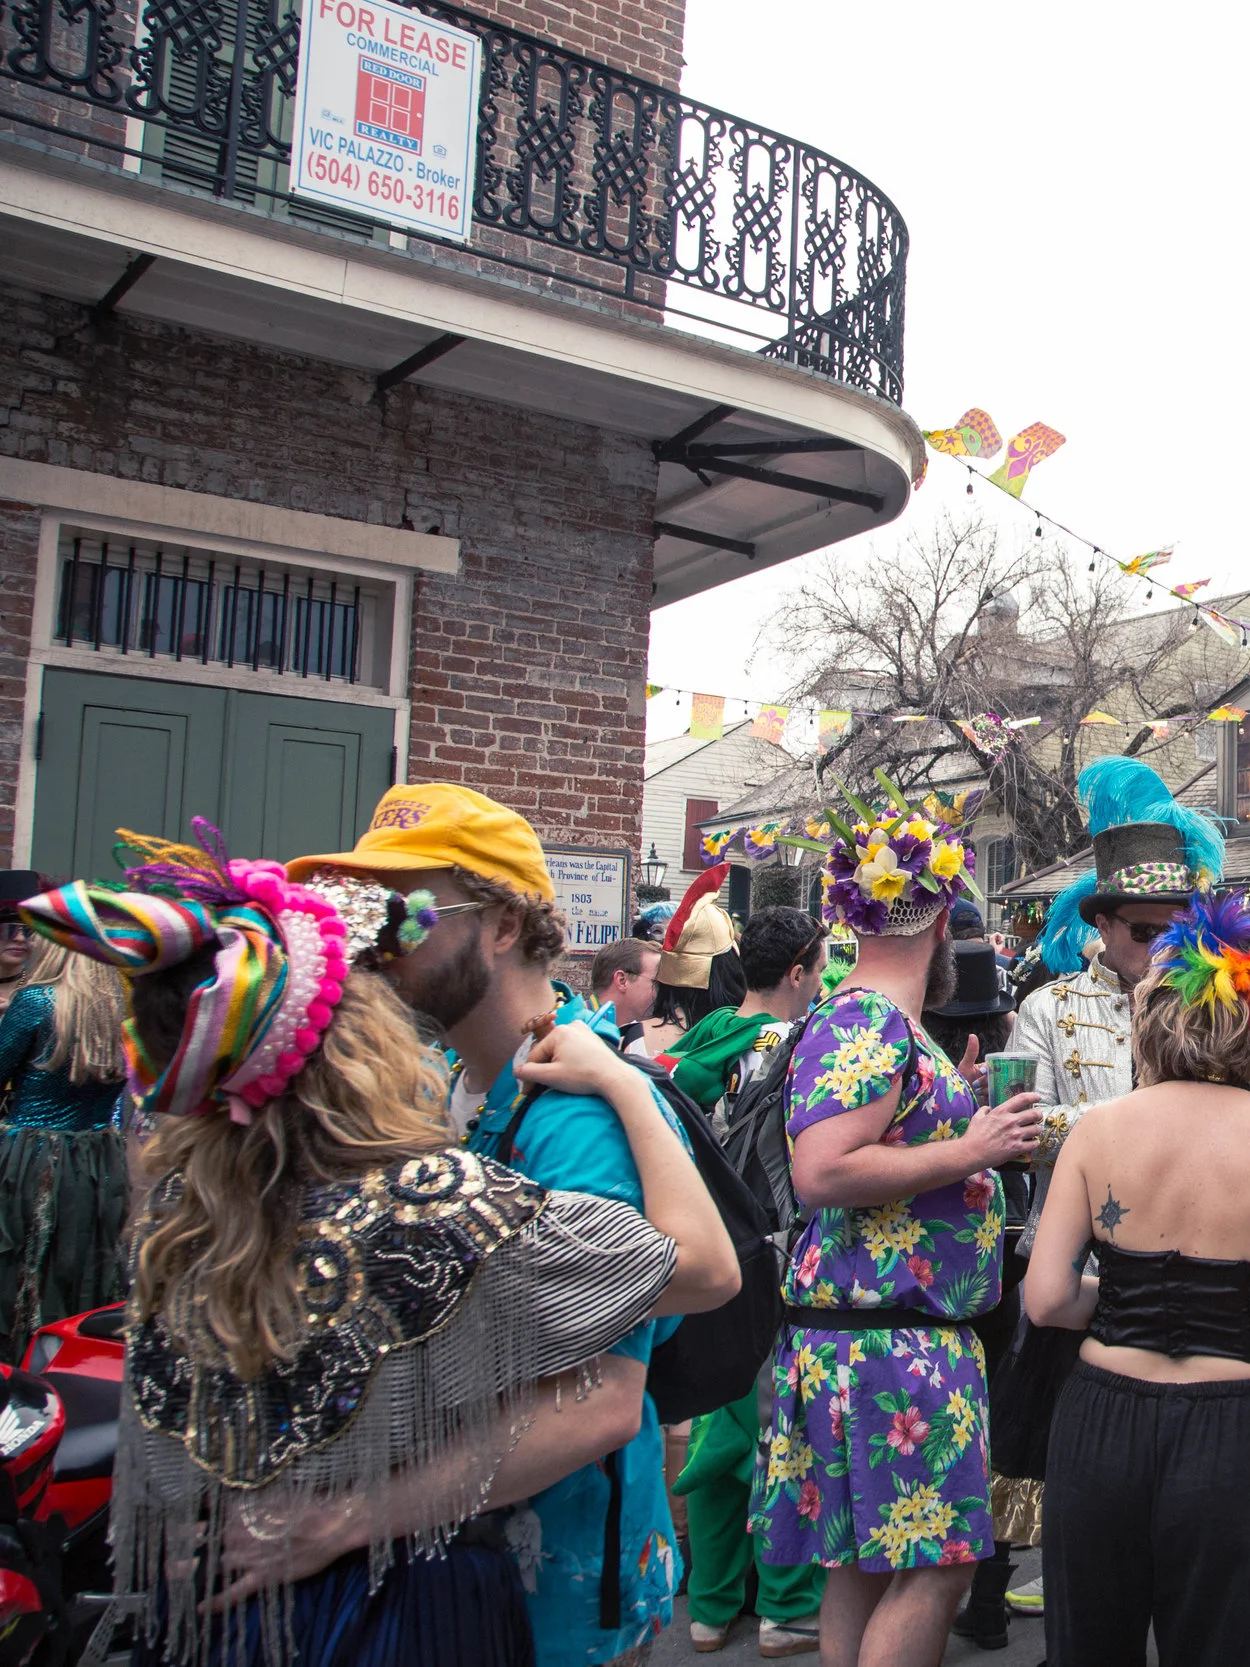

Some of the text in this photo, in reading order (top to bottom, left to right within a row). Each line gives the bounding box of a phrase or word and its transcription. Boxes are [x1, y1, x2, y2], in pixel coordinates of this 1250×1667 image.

[319, 0, 467, 71] FOR LEASE
[346, 32, 440, 77] COMMERCIAL
[363, 59, 422, 90] RED DOOR
[360, 124, 417, 150] REALTY
[309, 126, 334, 151] VIC
[338, 136, 405, 173] PALAZZO
[416, 161, 461, 190] Broker
[307, 151, 460, 221] (504) 650-3116
[546, 857, 618, 872] rleans was the Capital
[557, 869, 589, 881] Province
[591, 872, 600, 882] of
[571, 893, 592, 904] 1803
[0, 1420, 45, 1456] HONDA
